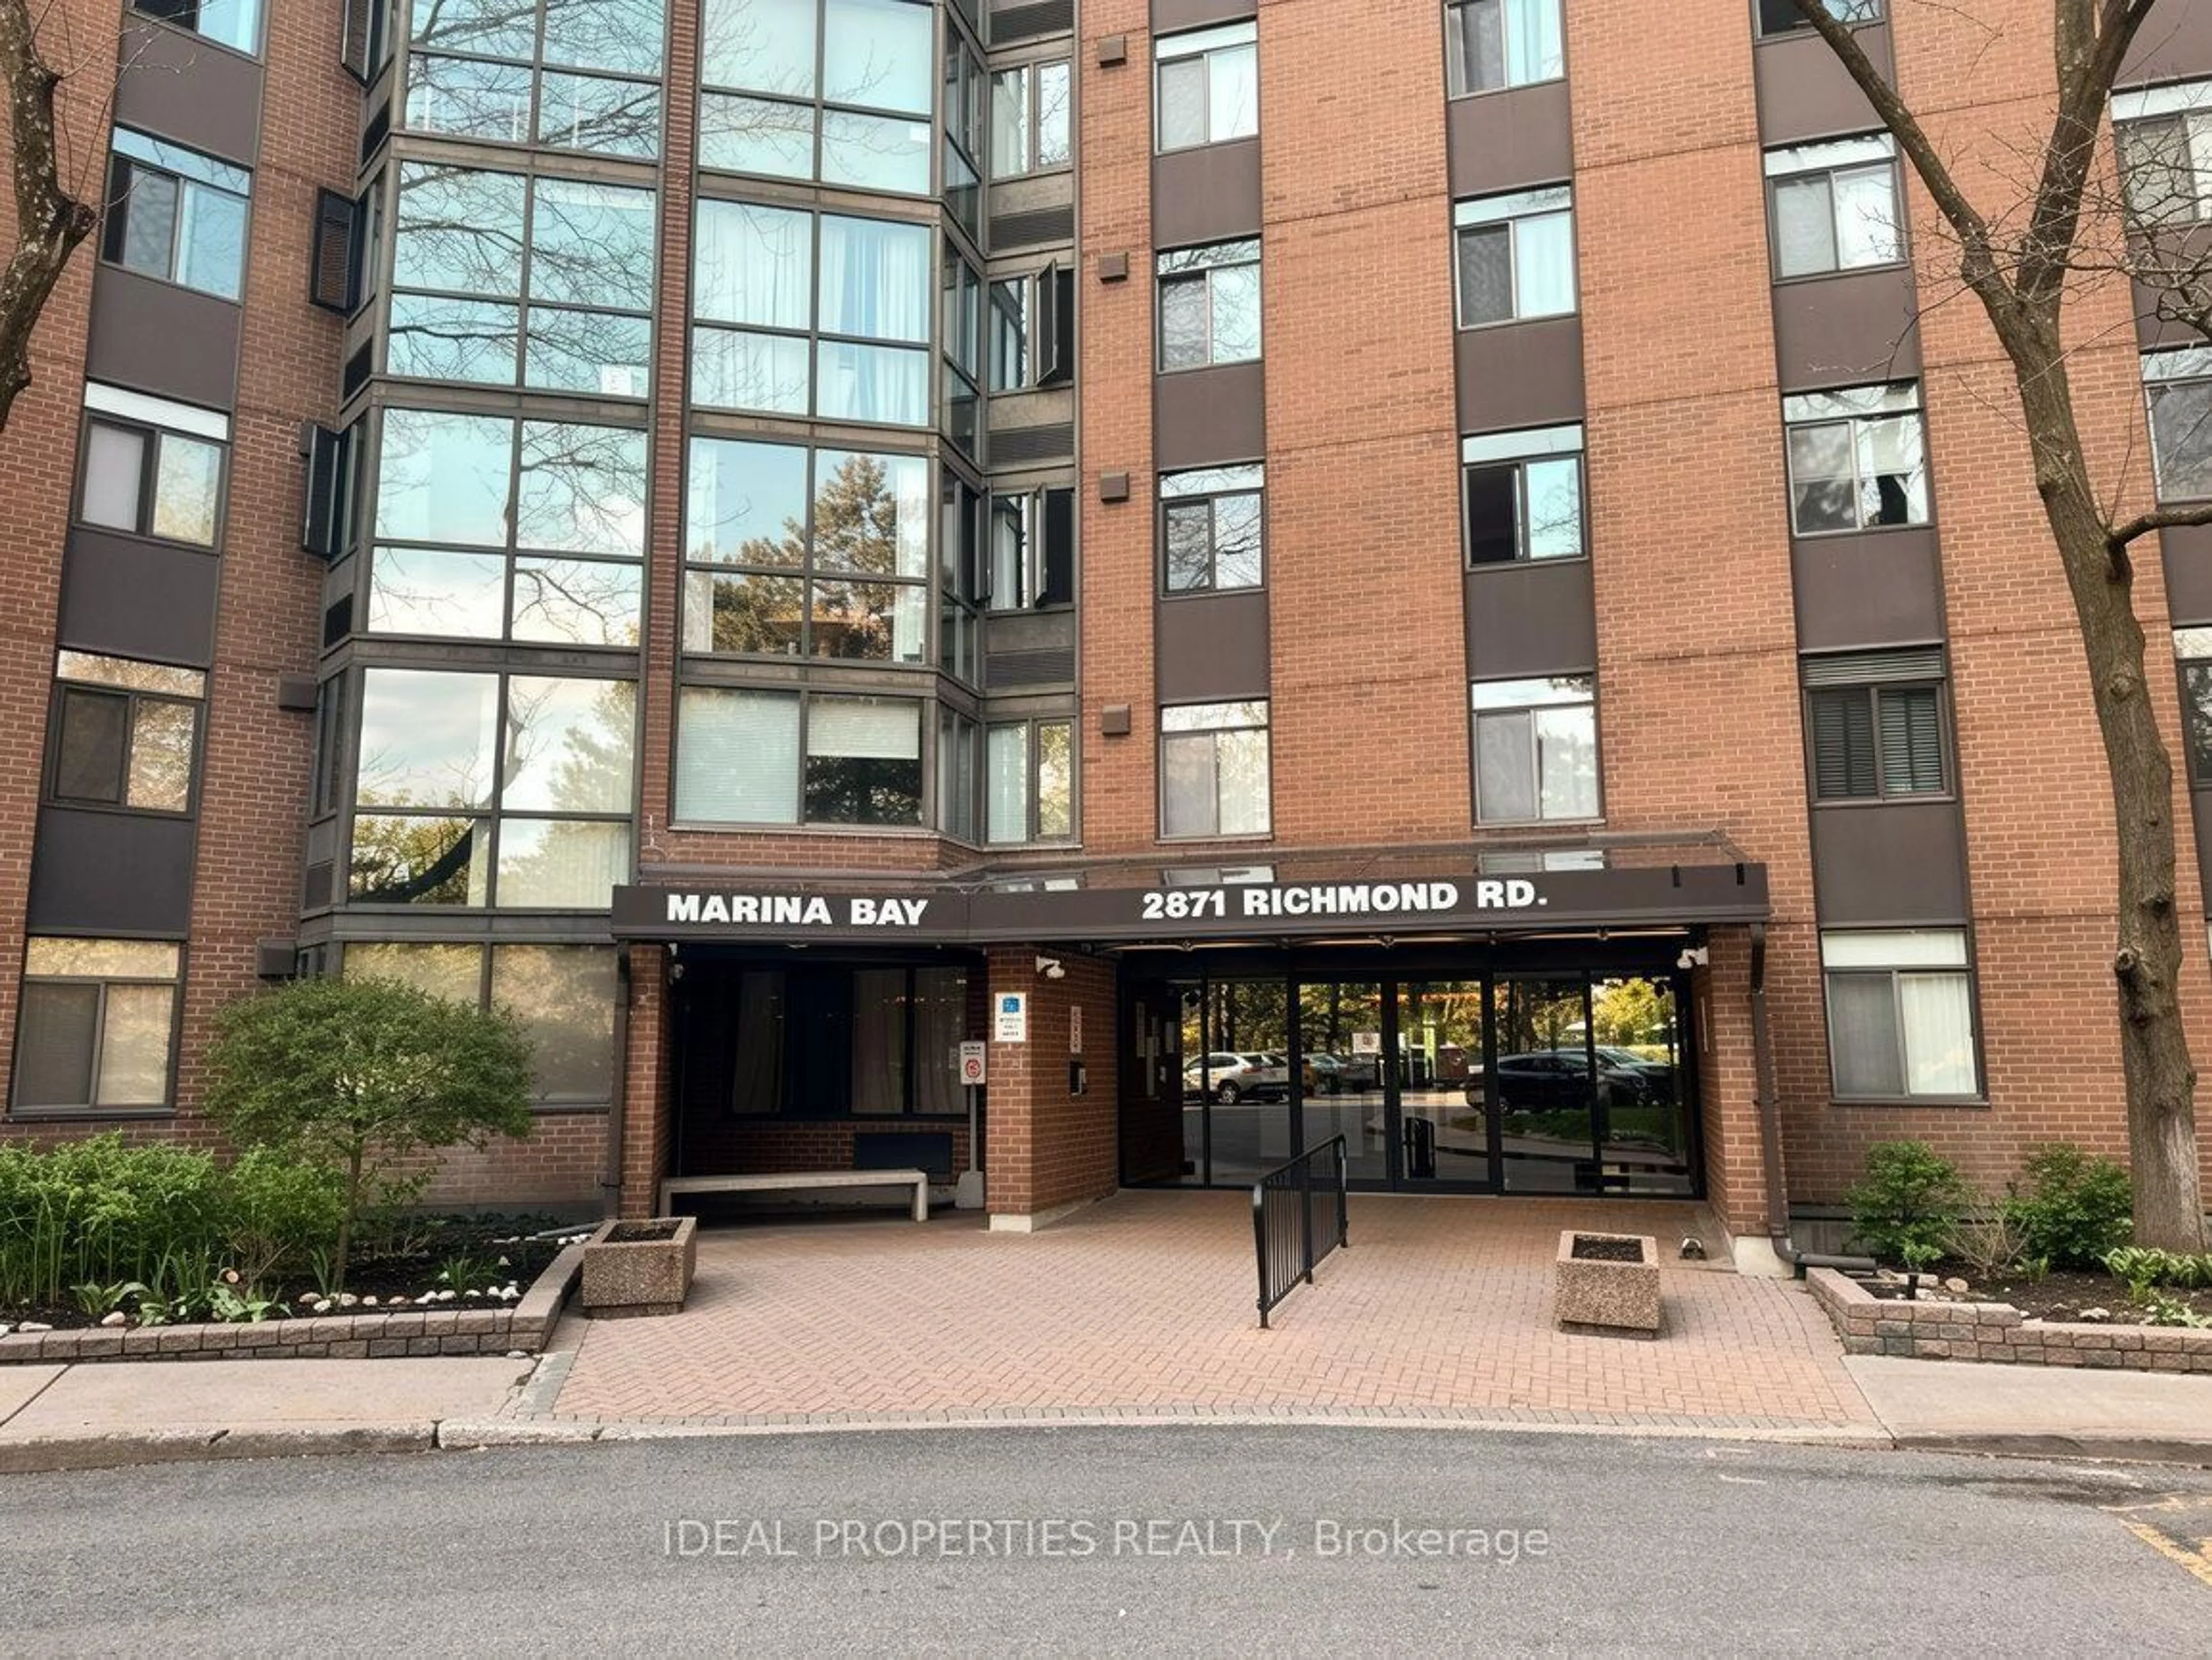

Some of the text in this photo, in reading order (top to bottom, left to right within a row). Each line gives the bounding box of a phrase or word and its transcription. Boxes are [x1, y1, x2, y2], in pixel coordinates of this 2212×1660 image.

[667, 895, 929, 925] MARINA BAY
[1142, 880, 1548, 919] 2871 RICHMOND RD.
